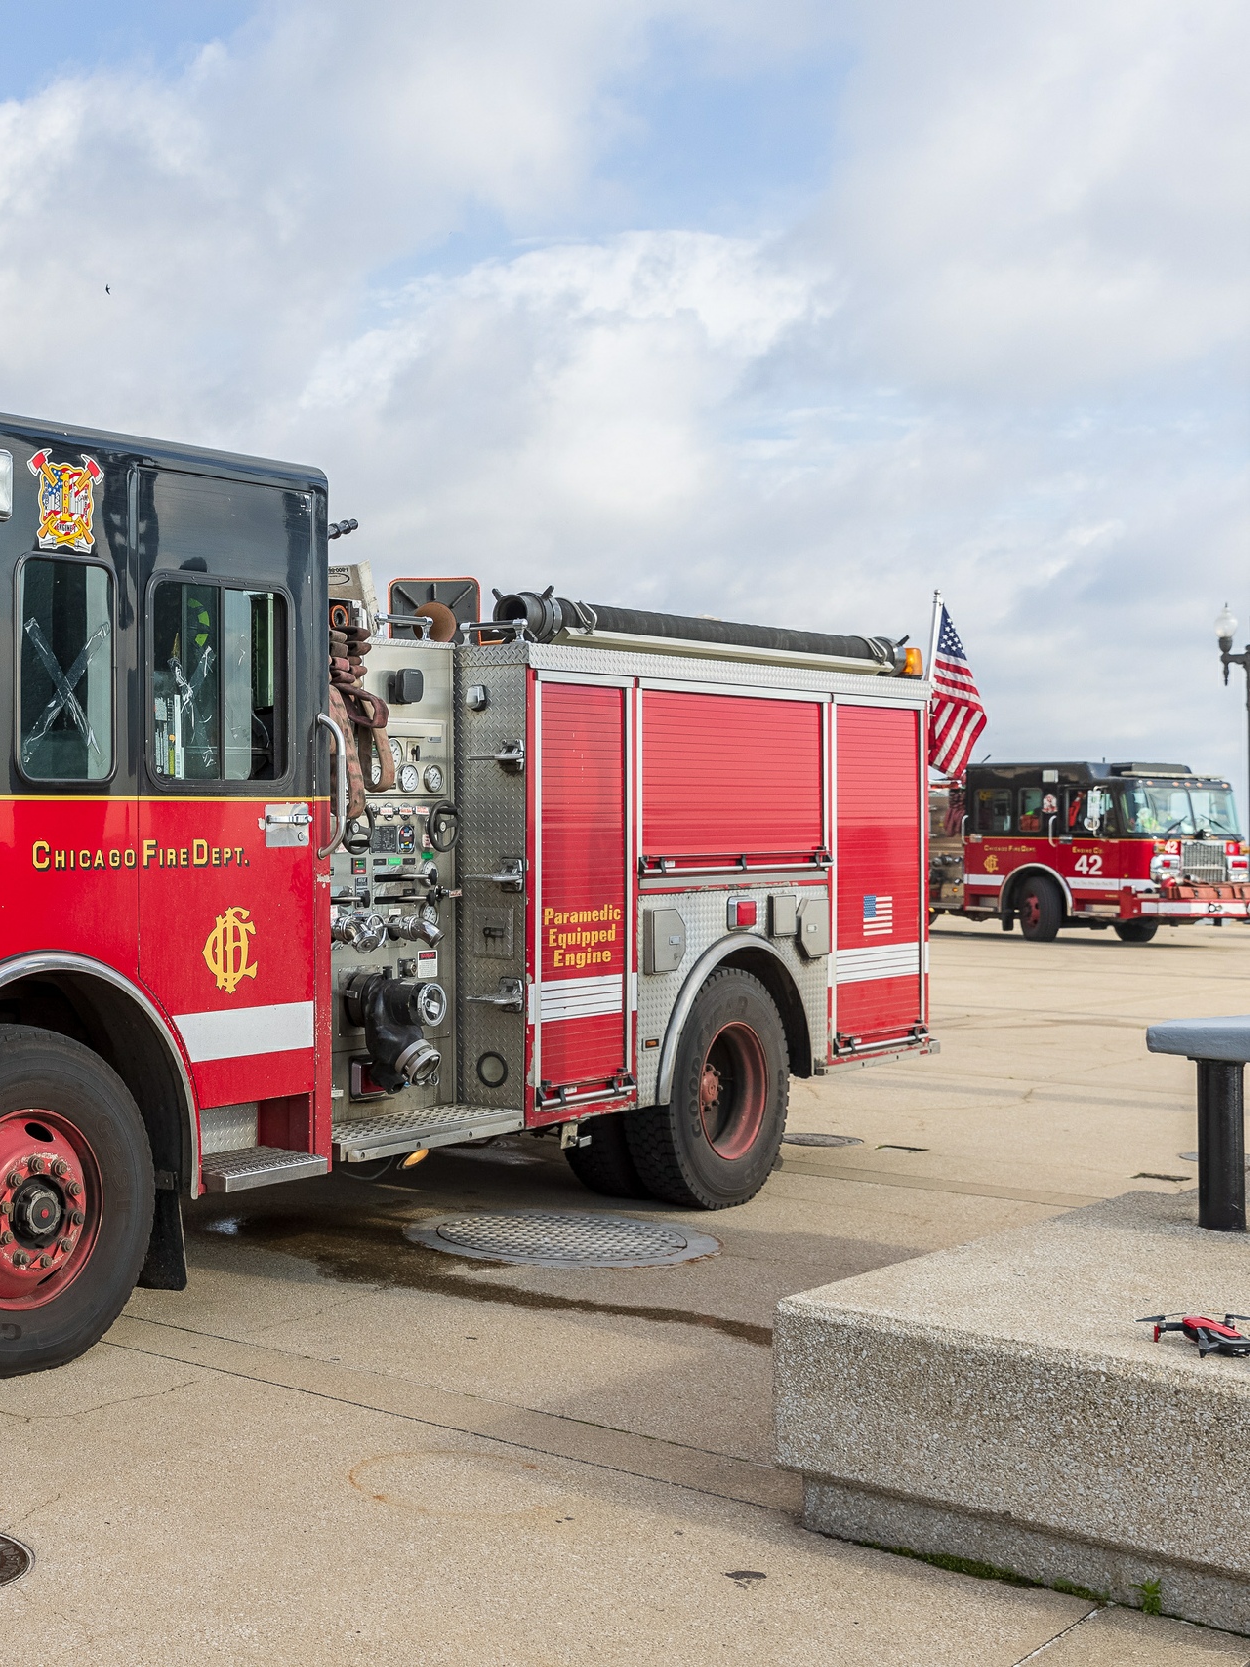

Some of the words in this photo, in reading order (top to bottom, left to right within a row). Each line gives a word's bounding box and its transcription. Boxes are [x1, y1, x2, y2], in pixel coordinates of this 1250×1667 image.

[32, 840, 138, 872] CHICAGO
[142, 839, 189, 869] FIRE
[192, 838, 250, 868] DEPT.
[1165, 841, 1178, 854] 42
[1074, 854, 1103, 875] 42
[544, 904, 621, 926] Paramedic
[549, 923, 616, 949] Equipped
[553, 947, 612, 969] Engine
